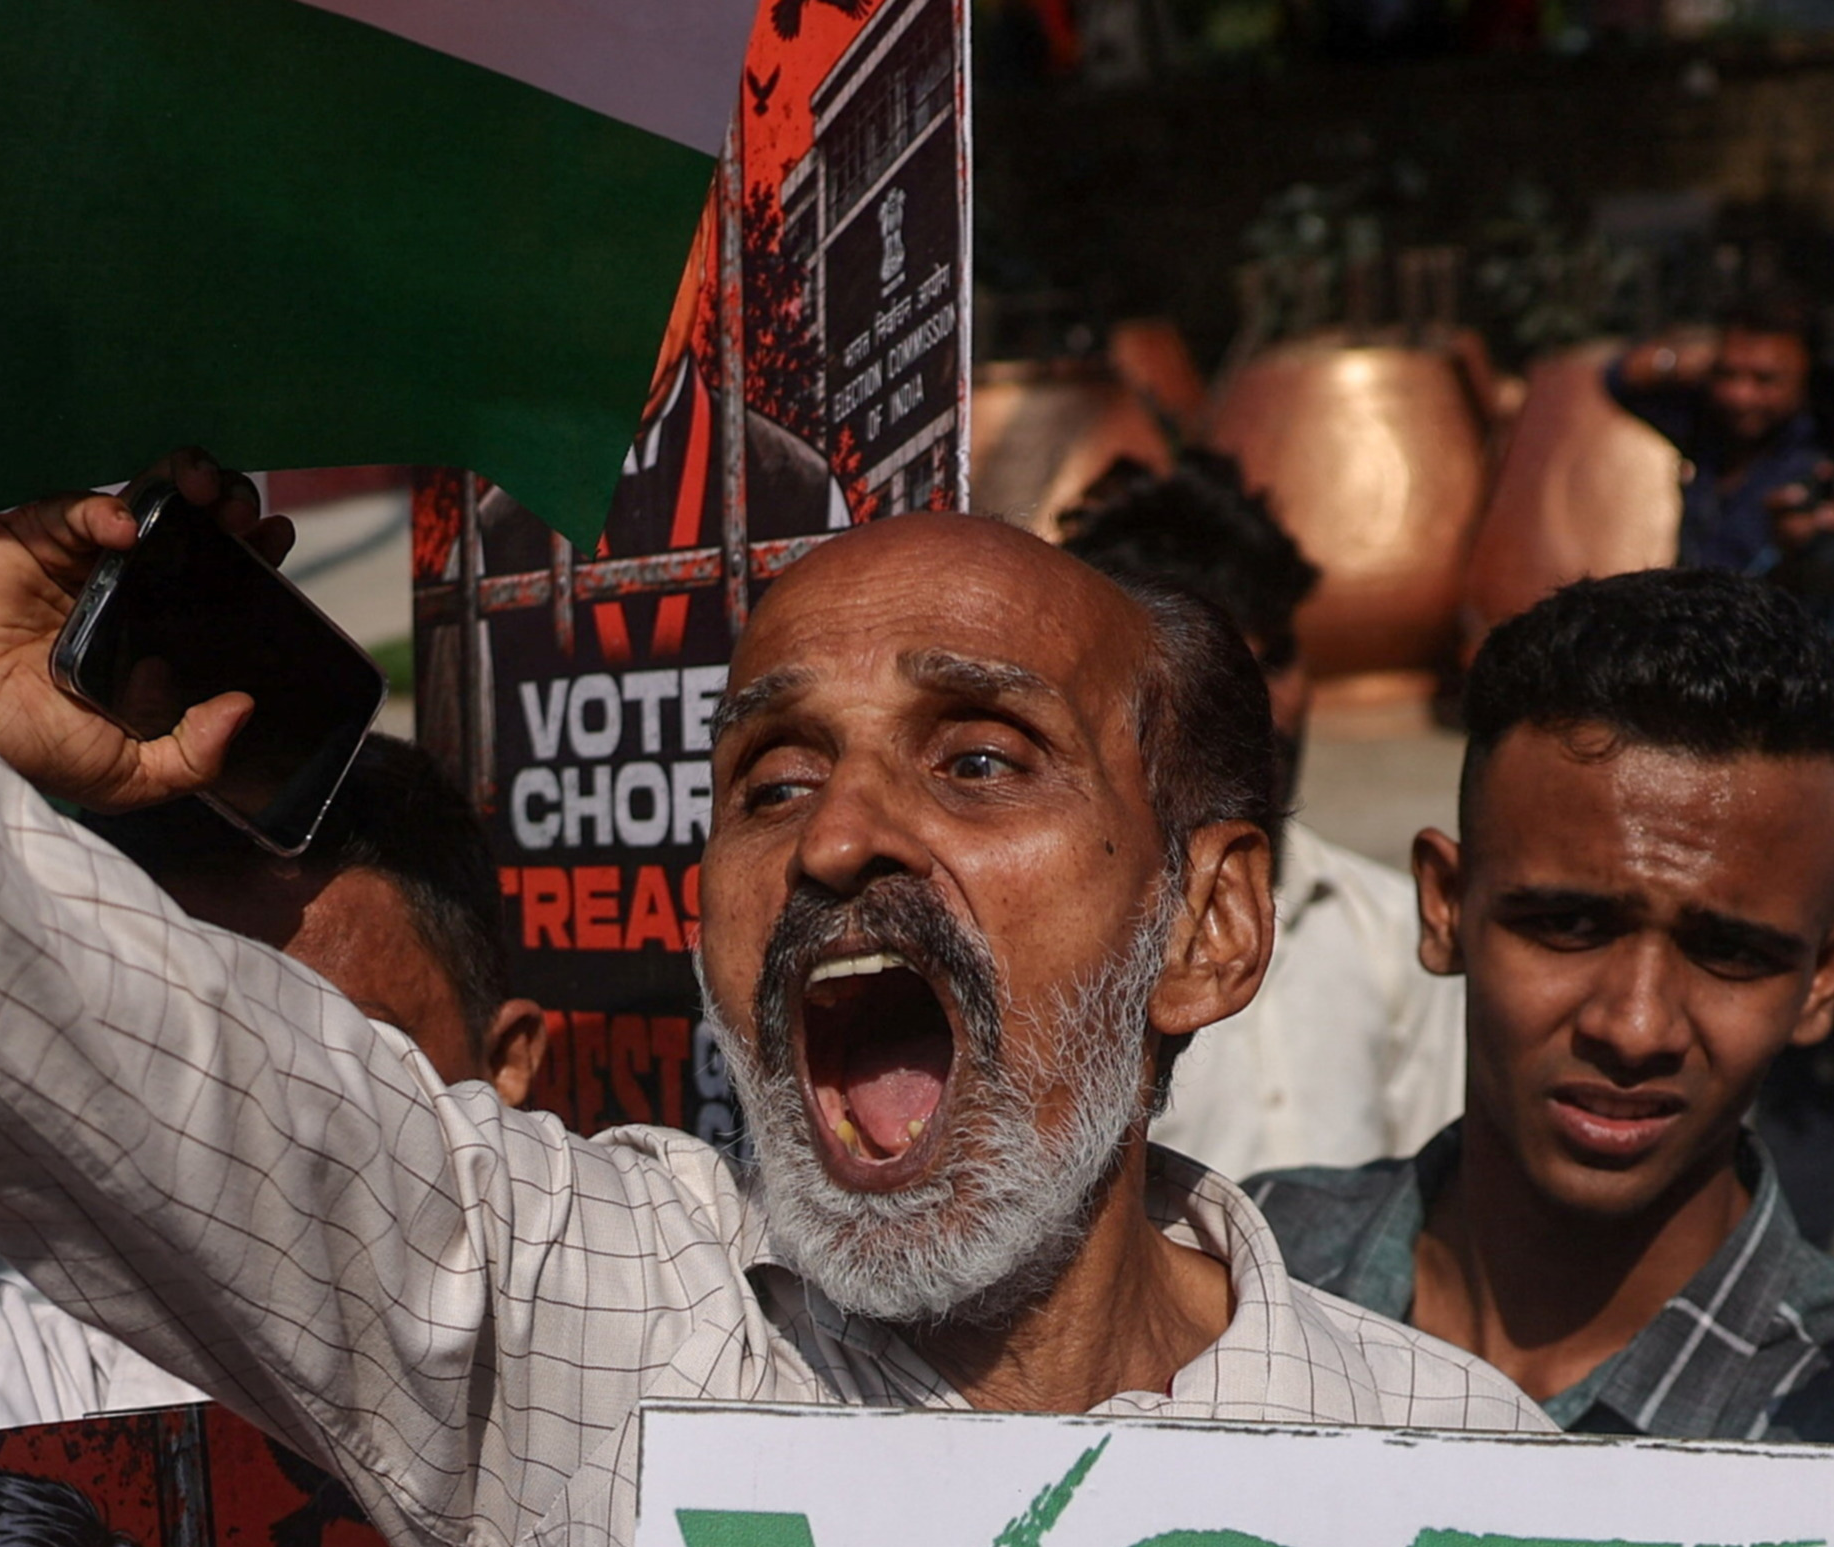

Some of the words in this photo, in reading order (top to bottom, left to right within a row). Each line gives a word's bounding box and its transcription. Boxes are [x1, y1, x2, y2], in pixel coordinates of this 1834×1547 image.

[833, 358, 883, 424] ELECTION
[887, 302, 956, 380] COMMISSION
[868, 403, 884, 442] OF
[890, 372, 925, 426] INDIA
[510, 760, 713, 850] CHOR
